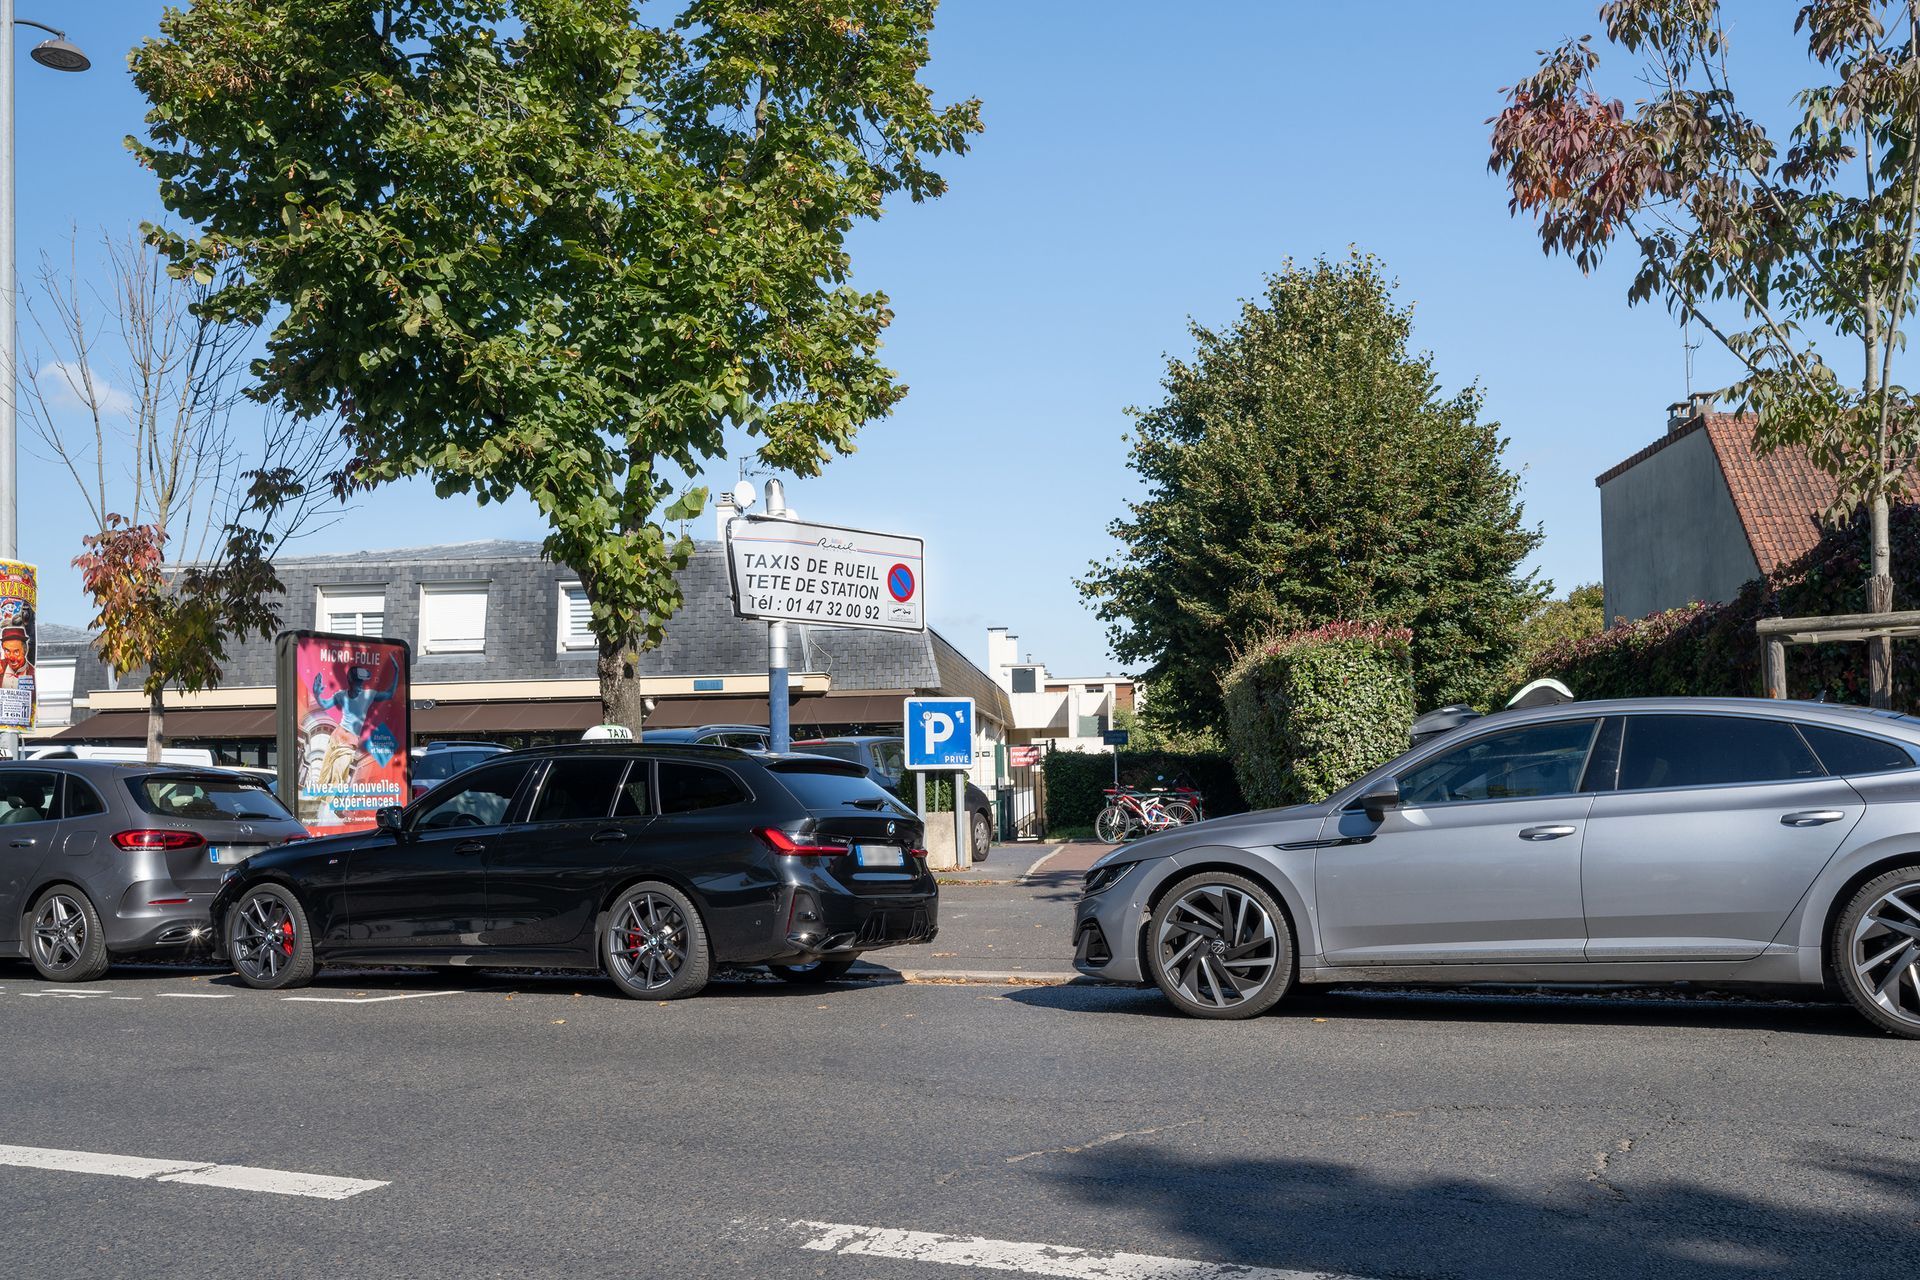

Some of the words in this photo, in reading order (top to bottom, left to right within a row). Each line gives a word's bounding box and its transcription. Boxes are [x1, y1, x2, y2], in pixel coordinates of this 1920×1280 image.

[817, 537, 856, 551] Rueil
[744, 553, 800, 571] TAXIS
[807, 558, 828, 574] DE
[834, 562, 879, 580] RUEIL
[746, 574, 791, 590] TETE
[795, 577, 816, 593] DE
[820, 580, 879, 600] STATION
[749, 594, 773, 610] Tél
[786, 597, 802, 612] 01
[806, 599, 823, 614] 47
[826, 601, 842, 616] 32
[846, 603, 861, 618] 00
[865, 605, 880, 620] 92
[320, 648, 380, 666] MICRO-FOLIE
[607, 728, 628, 738] TAXI
[924, 712, 954, 755] P
[944, 753, 969, 763] PRIVÉ
[306, 780, 334, 793] Vivez
[337, 780, 349, 793] de
[352, 779, 400, 793] nouvelles
